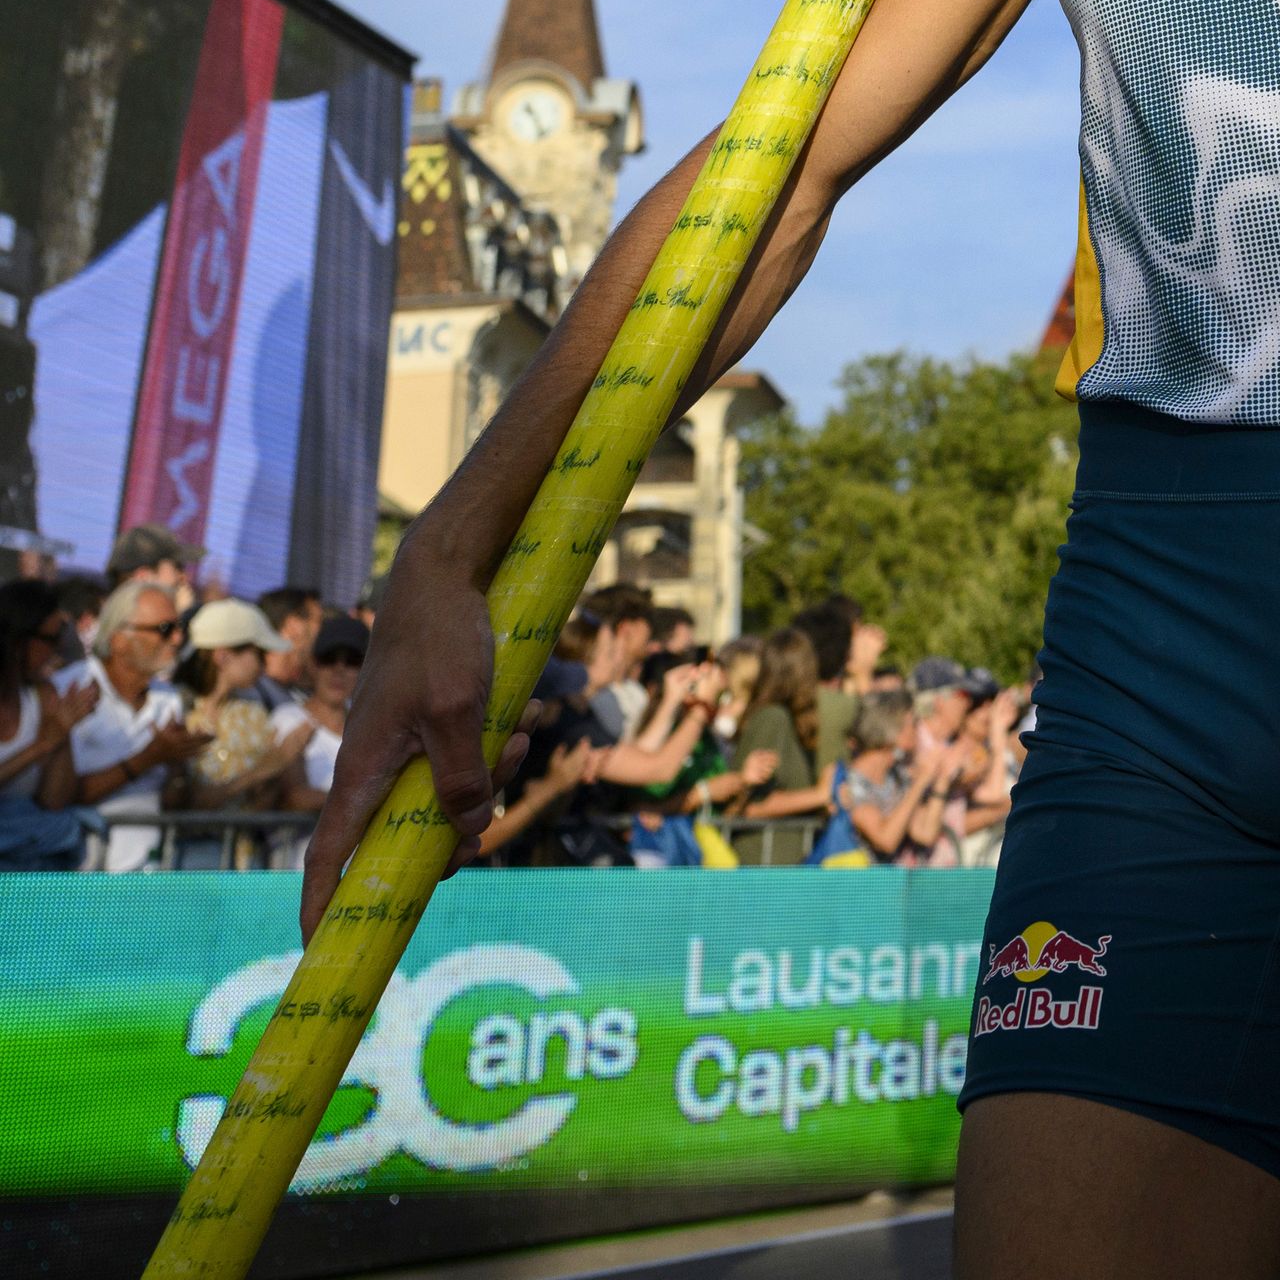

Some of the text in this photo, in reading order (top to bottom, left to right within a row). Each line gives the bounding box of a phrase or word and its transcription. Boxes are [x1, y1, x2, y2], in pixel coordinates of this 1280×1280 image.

[685, 937, 981, 1018] Lausann
[974, 985, 1104, 1038] Red Bull
[468, 1007, 639, 1089] ans
[675, 1017, 967, 1133] Capitale
